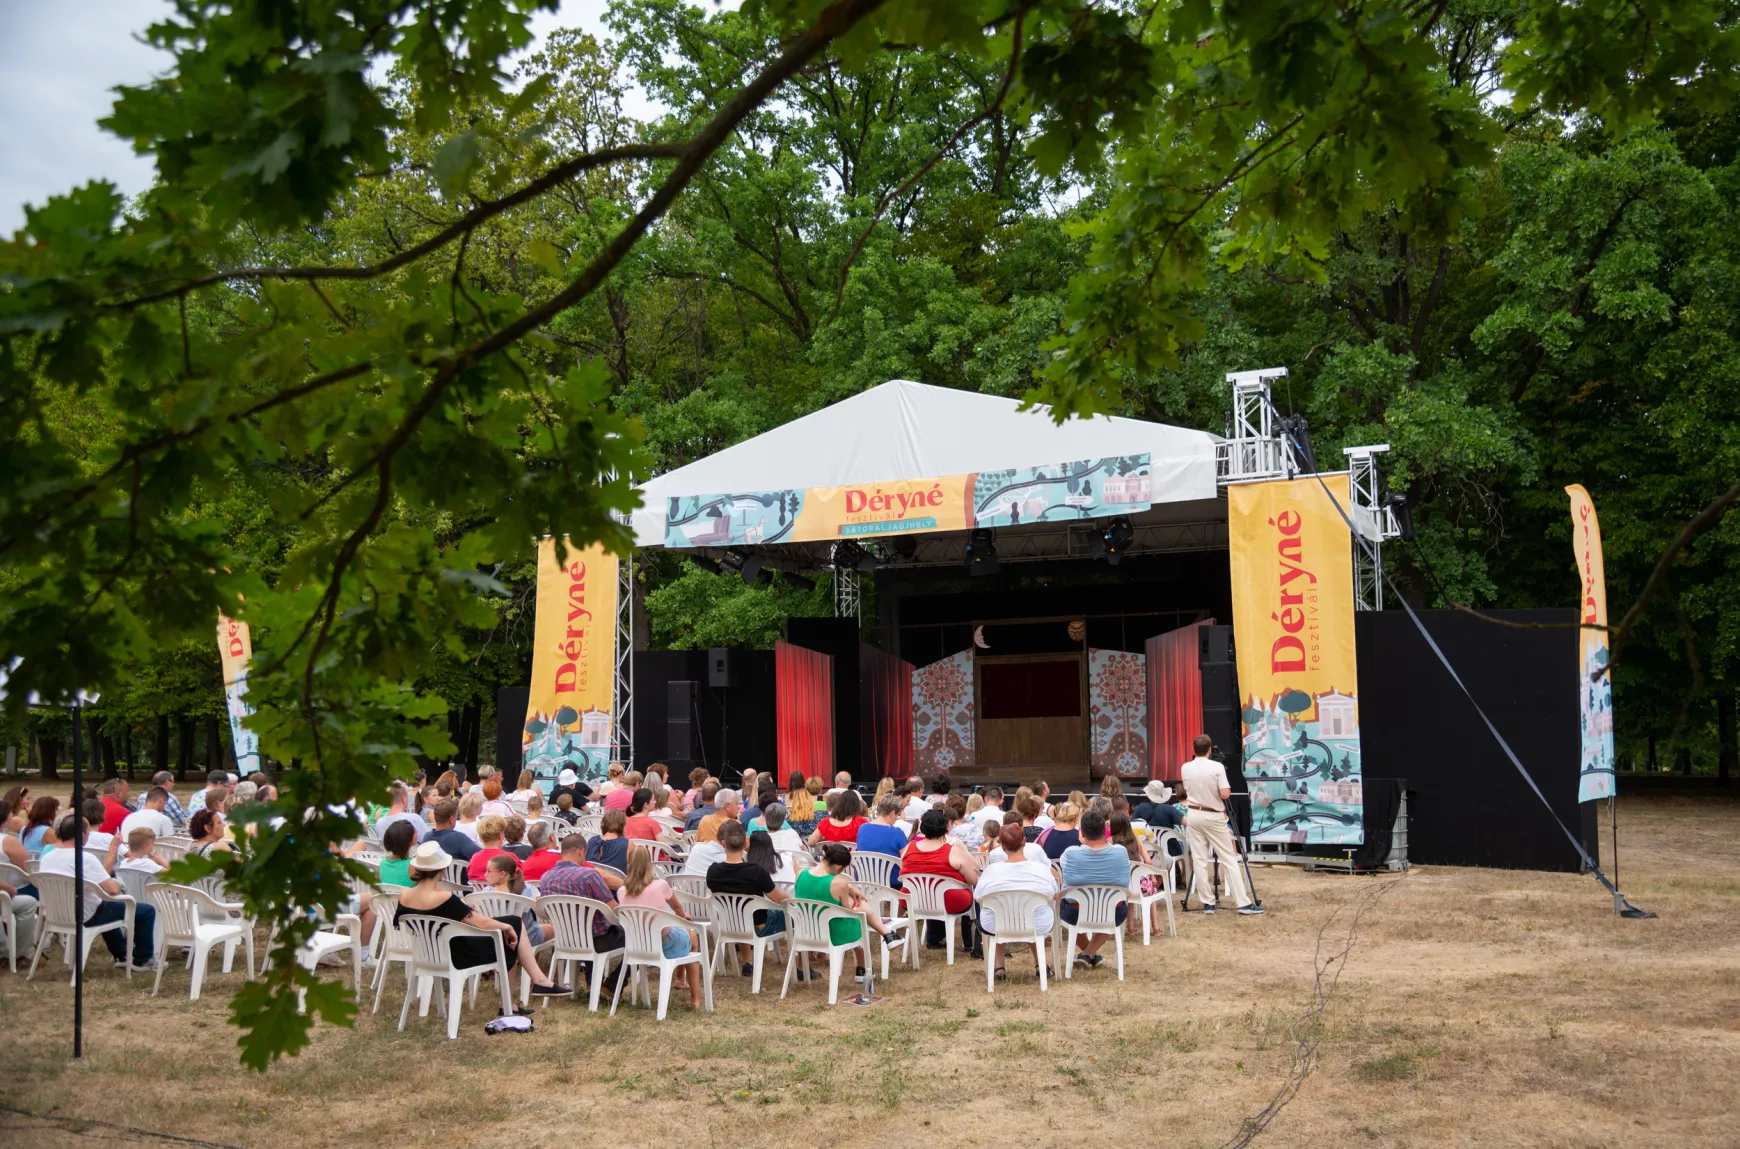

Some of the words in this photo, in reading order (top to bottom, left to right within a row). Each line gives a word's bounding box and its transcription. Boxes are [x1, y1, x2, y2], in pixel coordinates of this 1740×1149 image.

[845, 483, 944, 518] Déryné
[845, 519, 932, 534] SÁTORALJAÚJHELY
[846, 511, 896, 523] fesztivál
[1268, 510, 1318, 676] Déryné
[554, 561, 593, 696] Déryné
[1306, 588, 1320, 672] fesztivál
